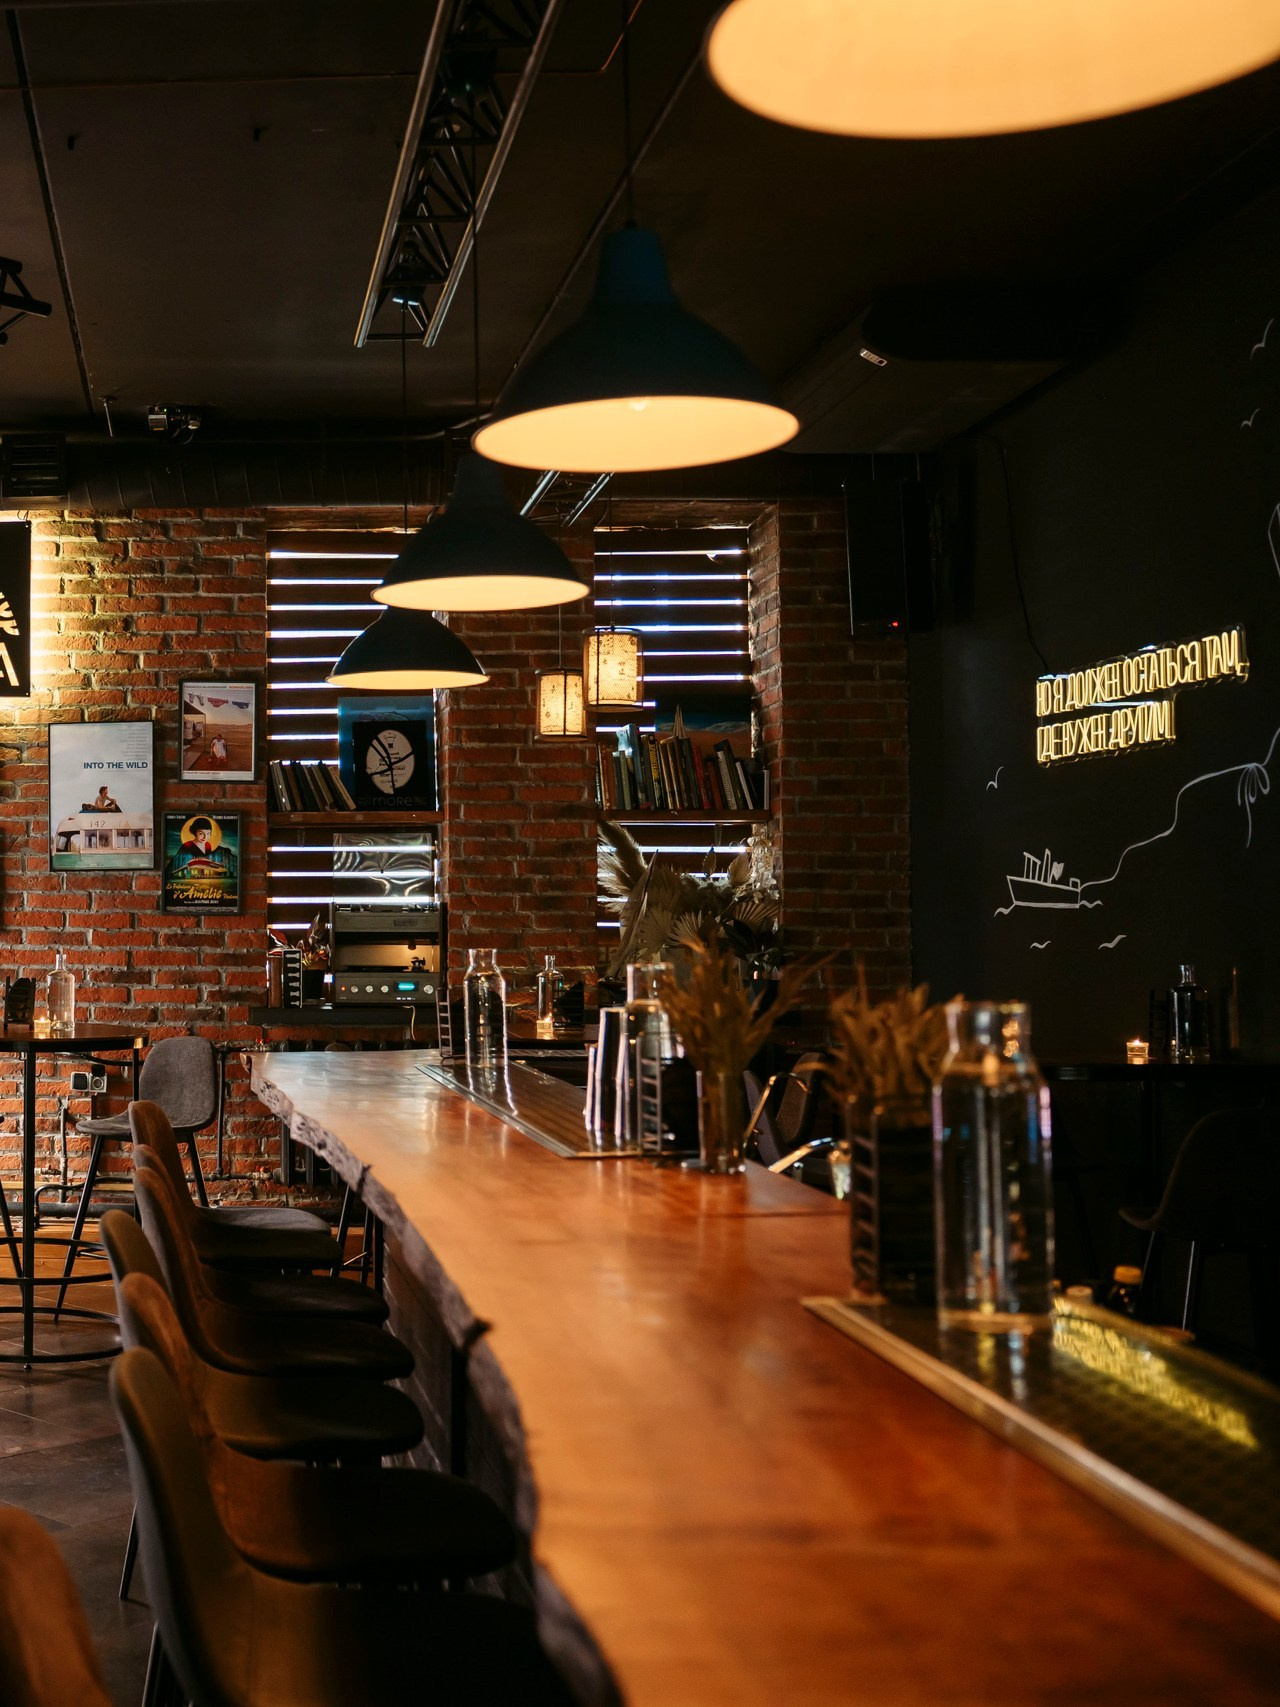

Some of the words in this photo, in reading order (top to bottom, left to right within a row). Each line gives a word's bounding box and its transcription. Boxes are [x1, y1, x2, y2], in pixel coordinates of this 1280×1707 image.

[1052, 677, 1066, 714] Я
[1065, 661, 1125, 711] ДОЛЖЕН
[1122, 640, 1205, 696] ОСТАТЬСЯ
[1036, 722, 1063, 763] ГДЕ
[1061, 713, 1111, 757] НУЖЕН
[1108, 700, 1176, 750] ДРУГИМ
[125, 761, 149, 769] WILD
[90, 820, 106, 828] 142
